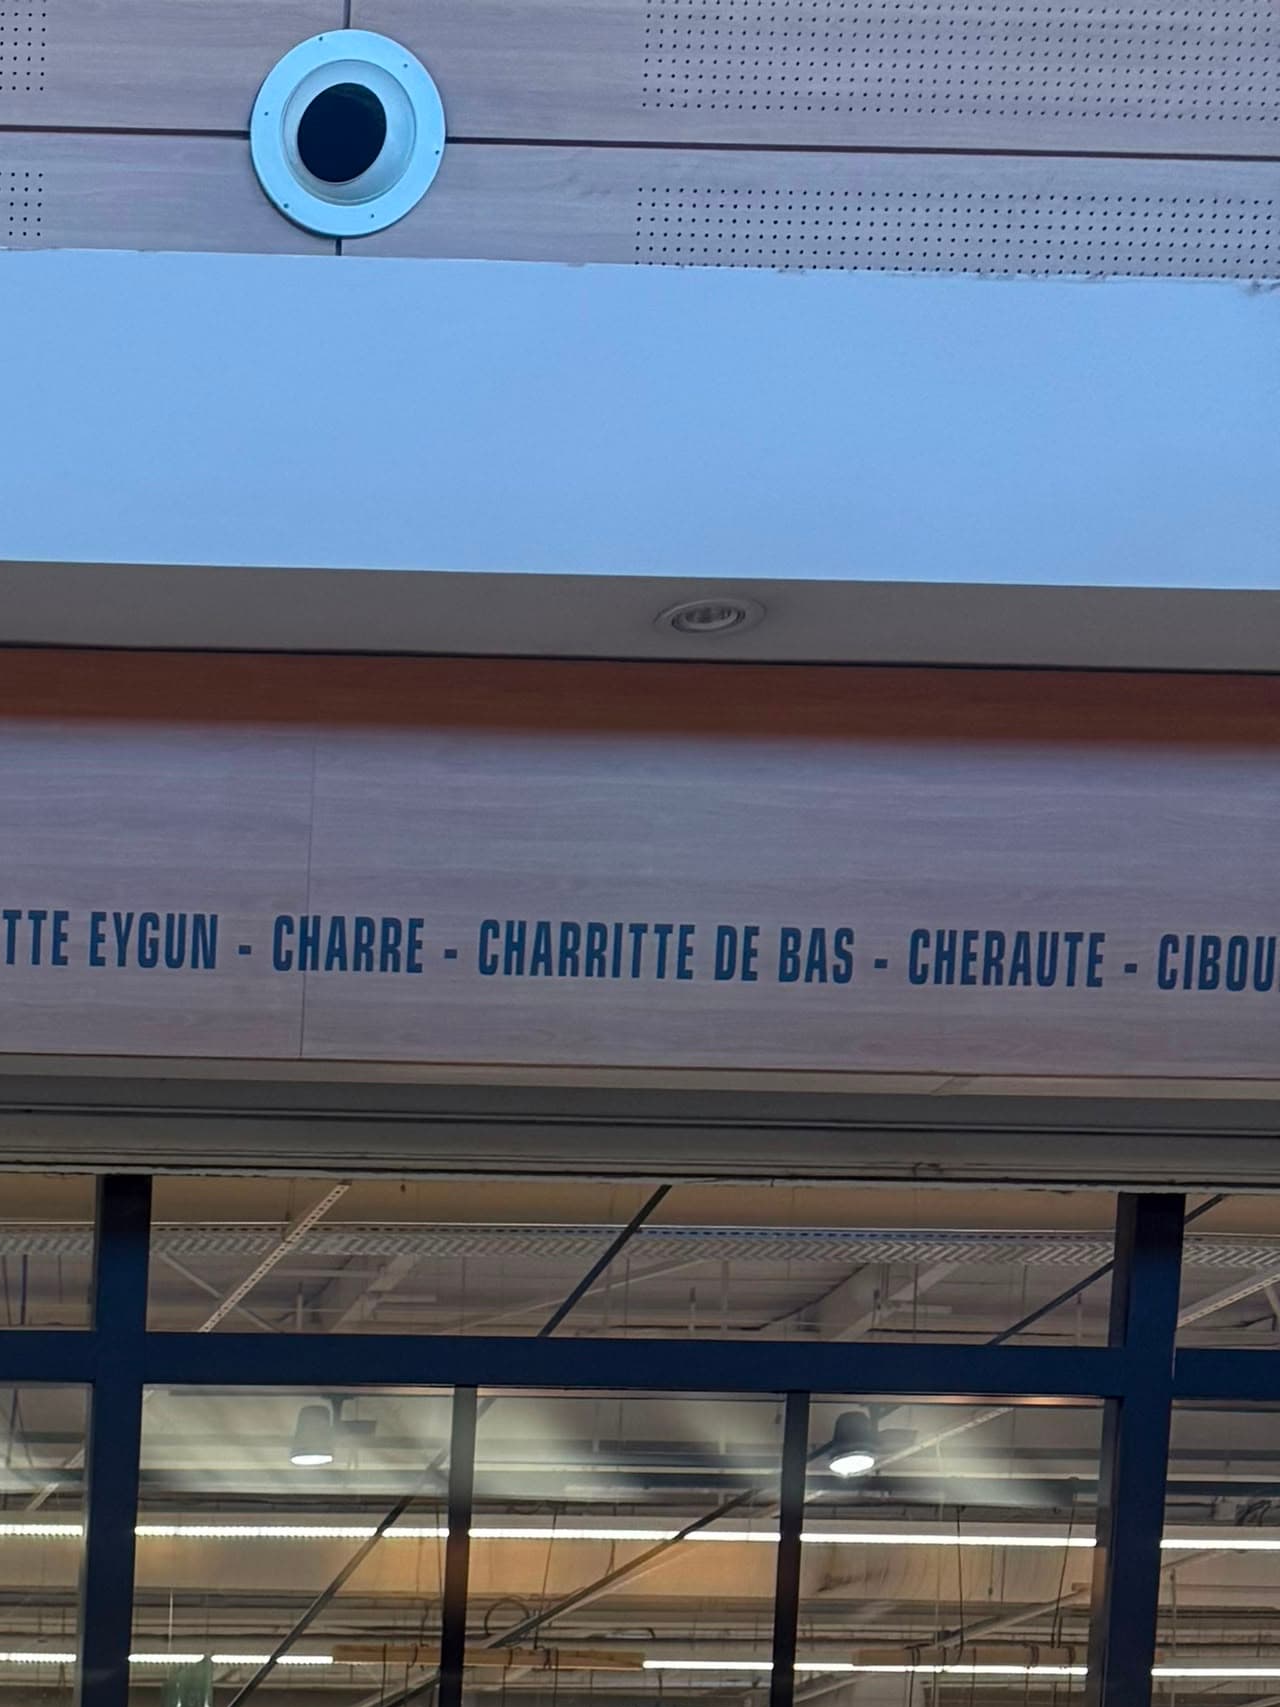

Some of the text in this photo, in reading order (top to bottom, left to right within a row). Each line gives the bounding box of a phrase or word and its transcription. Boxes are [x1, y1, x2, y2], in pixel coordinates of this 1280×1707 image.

[89, 911, 218, 970] EYGUN
[273, 915, 425, 974] CHARRE
[478, 919, 695, 980] CHARRITTE
[714, 925, 760, 982] DE
[778, 927, 855, 984] BAS
[909, 929, 1105, 988] CHERAUTE
[1157, 934, 1278, 993] CIBOU
